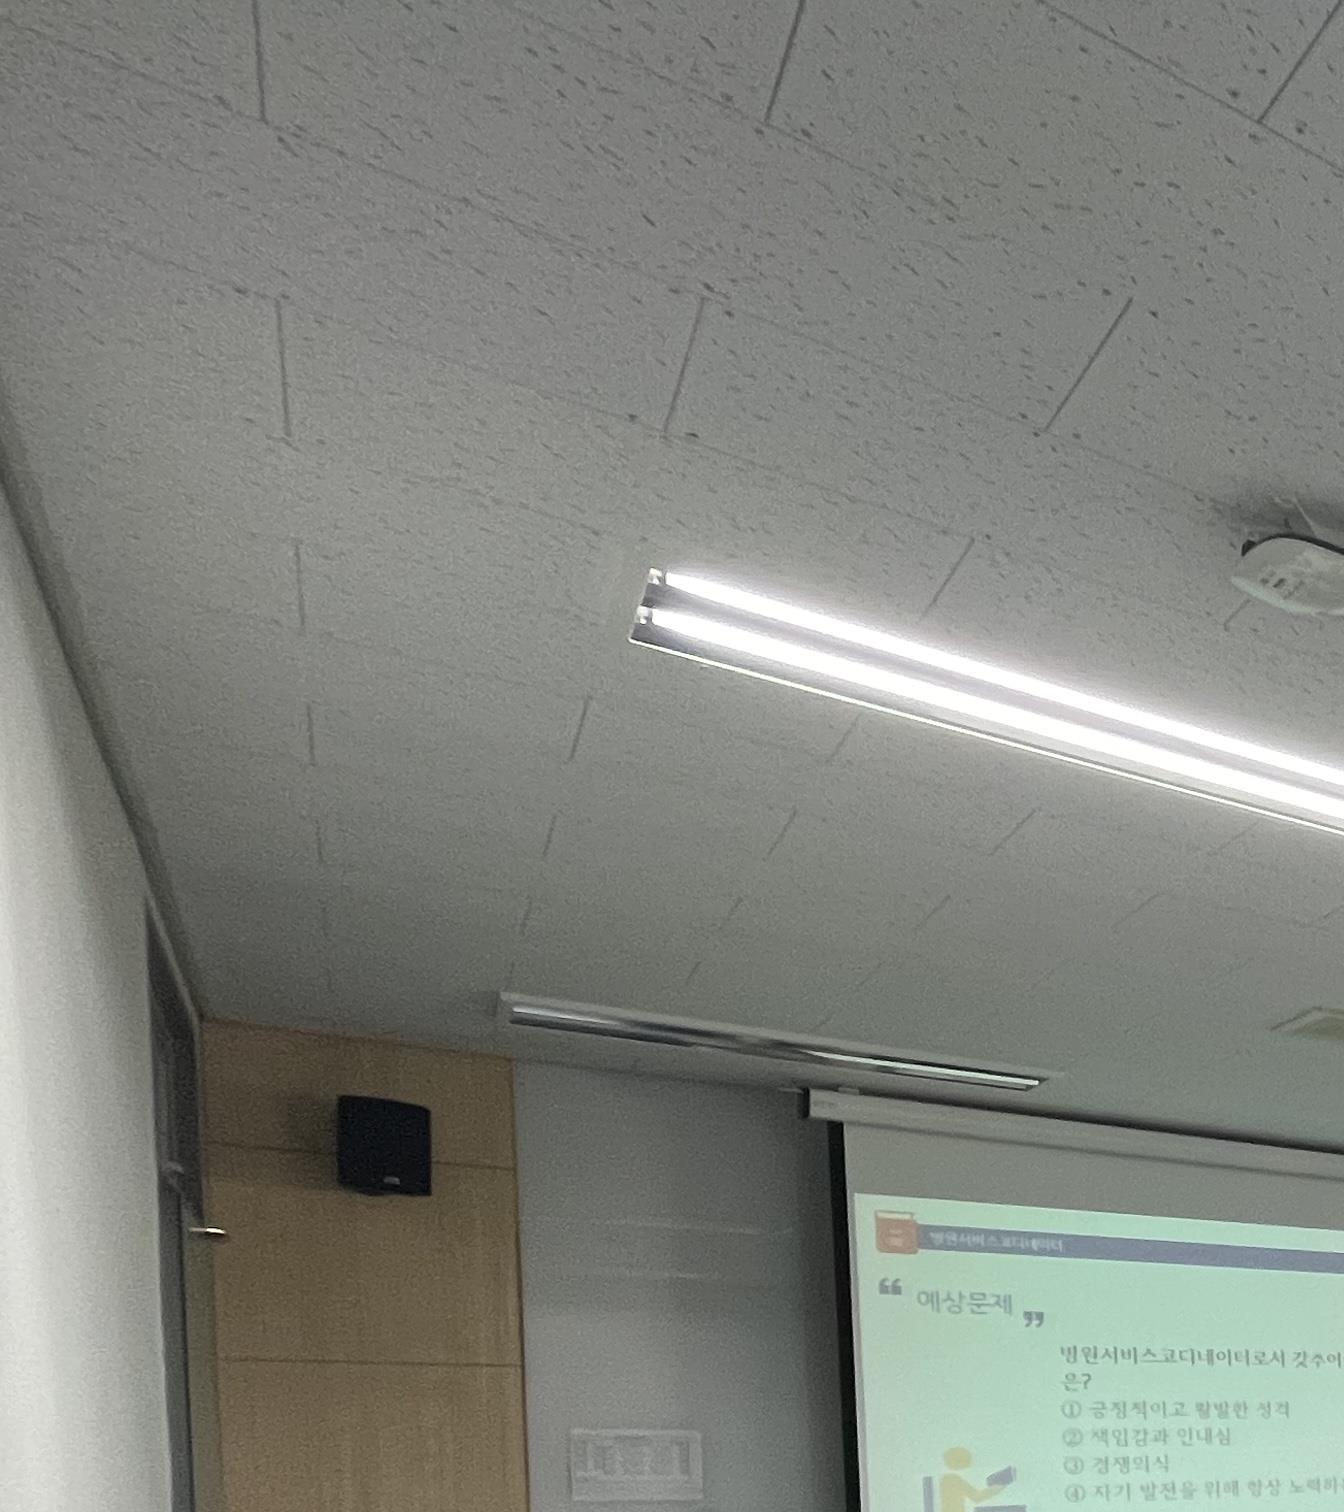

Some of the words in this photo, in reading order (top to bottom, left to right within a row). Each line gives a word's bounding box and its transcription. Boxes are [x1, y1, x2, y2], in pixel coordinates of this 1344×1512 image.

[916, 1291, 1013, 1316] 예상문제
[1060, 1345, 1287, 1368] 병원서비스코디네이터로서
[1062, 1372, 1092, 1391] 은?
[1089, 1401, 1191, 1420] 긍정적이고
[1091, 1427, 1169, 1448] 책임감과
[1177, 1427, 1232, 1447] 인내심
[1094, 1482, 1132, 1502] 자기
